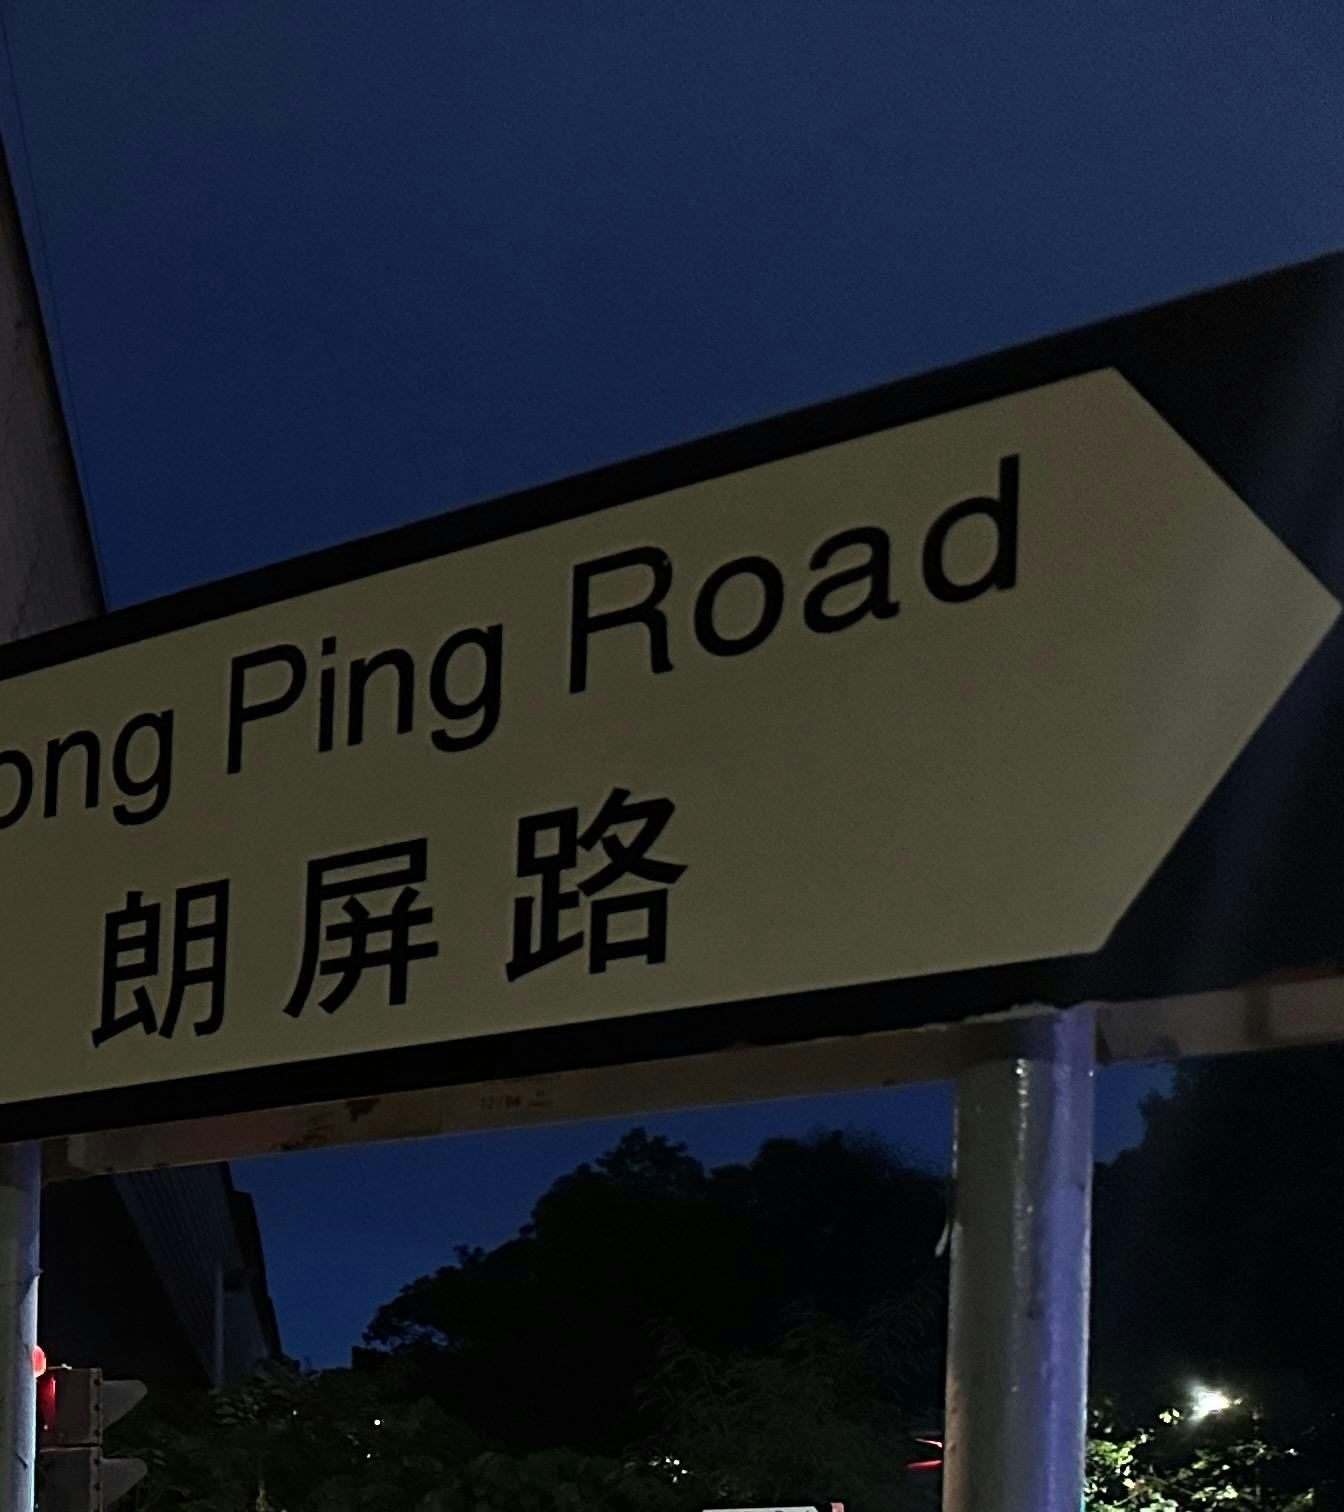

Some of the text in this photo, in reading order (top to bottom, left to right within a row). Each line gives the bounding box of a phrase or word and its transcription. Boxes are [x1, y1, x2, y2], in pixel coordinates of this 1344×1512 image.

[226, 621, 505, 774] Ping
[569, 453, 1021, 694] Road
[89, 786, 688, 1049] 朗屏路
